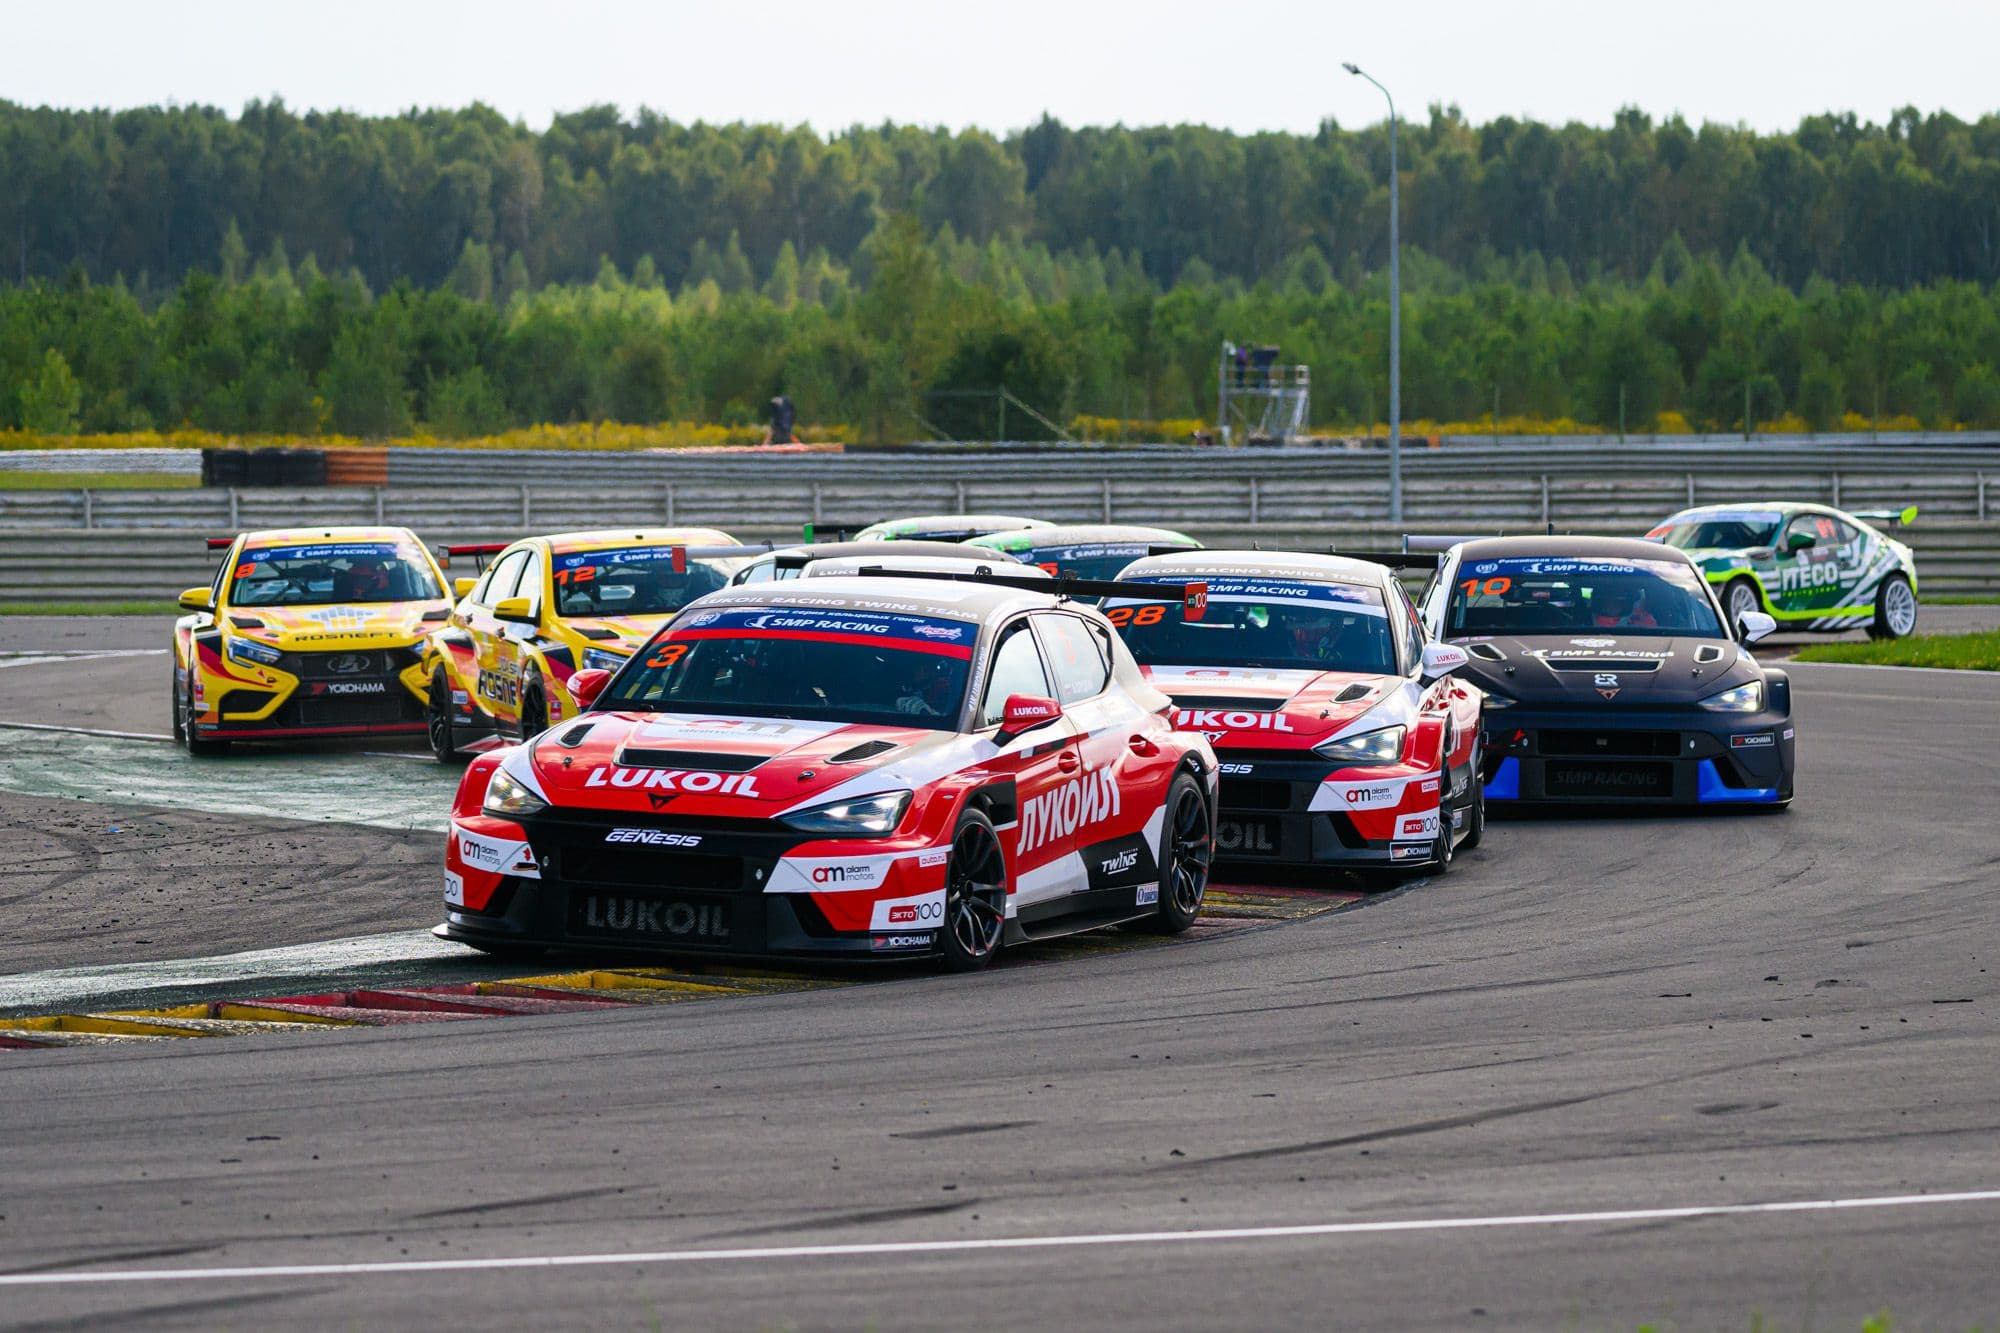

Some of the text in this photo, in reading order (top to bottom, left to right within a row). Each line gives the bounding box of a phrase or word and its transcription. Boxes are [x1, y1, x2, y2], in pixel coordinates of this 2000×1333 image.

[234, 563, 257, 579] 8
[554, 566, 596, 585] 12
[1129, 567, 1190, 575] LUKOIL
[1196, 567, 1262, 575] RACING
[1268, 569, 1325, 578] TWINS
[1544, 564, 1634, 573] SMP RACING
[1245, 586, 1309, 596] RACING
[1460, 577, 1511, 597] 10
[700, 597, 978, 620] LUKOIL RACING TWINS TEAM
[1106, 606, 1166, 627] 28
[771, 617, 890, 633] SMP RACING
[295, 632, 397, 642] ROSNEFT
[646, 644, 688, 669] 3
[1599, 650, 1674, 658] RACING
[328, 683, 385, 694] YOKOHAMA
[1013, 707, 1048, 716] LUKOIL
[1178, 710, 1294, 732] UKOIL
[585, 767, 760, 798] LUKOIL
[1346, 789, 1370, 803] am
[1017, 761, 1120, 857] ЛУКОЙЛ
[605, 831, 703, 847] GENESIS
[1216, 822, 1273, 850] OIL
[481, 846, 498, 857] alarm
[921, 855, 946, 865] auto.ru
[1101, 852, 1138, 874] TWINS
[812, 866, 845, 883] am
[846, 864, 871, 873] alarm
[846, 872, 875, 881] motors
[587, 896, 729, 937] LUKOIL
[914, 902, 942, 921] 100
[888, 935, 931, 947] YOKOHAMA
